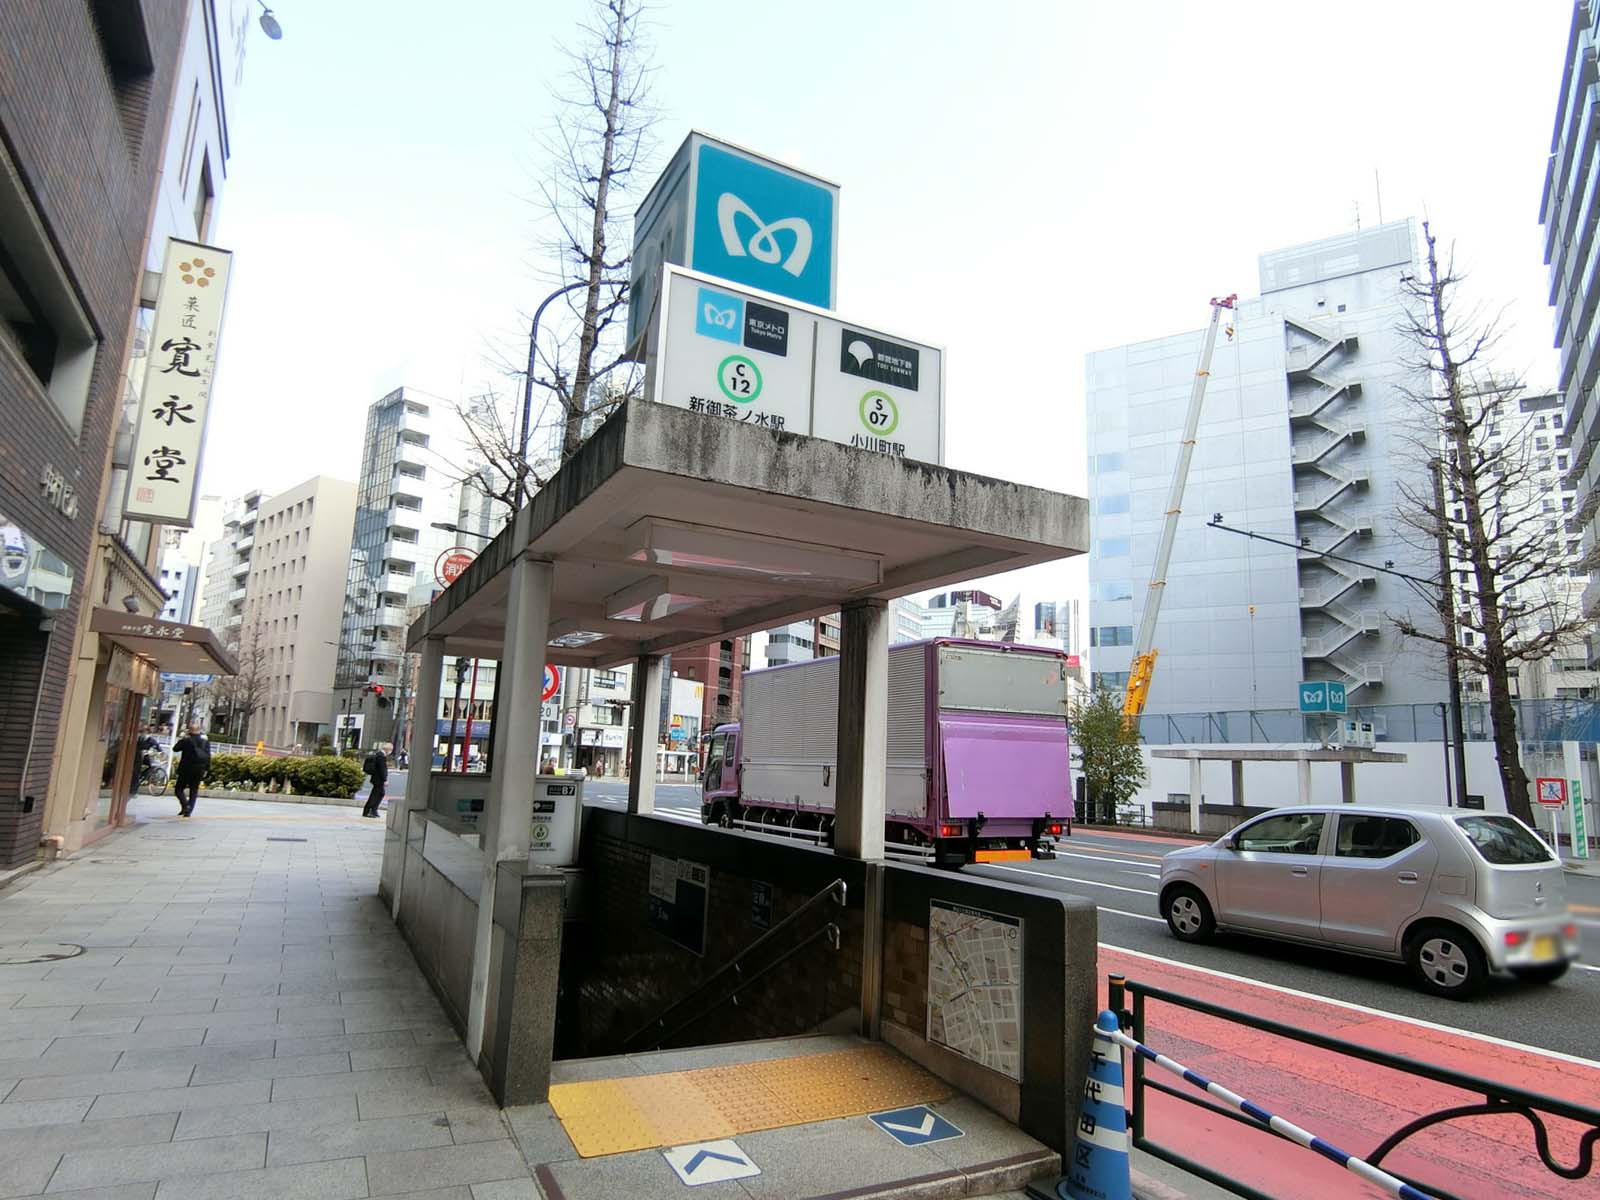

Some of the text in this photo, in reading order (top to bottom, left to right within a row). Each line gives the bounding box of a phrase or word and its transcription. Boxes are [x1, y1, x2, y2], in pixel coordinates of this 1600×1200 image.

[735, 364, 745, 377] C
[731, 377, 750, 393] 12
[875, 398, 883, 411] S
[689, 396, 785, 431] 新御茶ノ水駅
[869, 411, 889, 426] 07
[850, 433, 905, 457] 小川町駅
[1075, 1051, 1106, 1168] 千代田区
